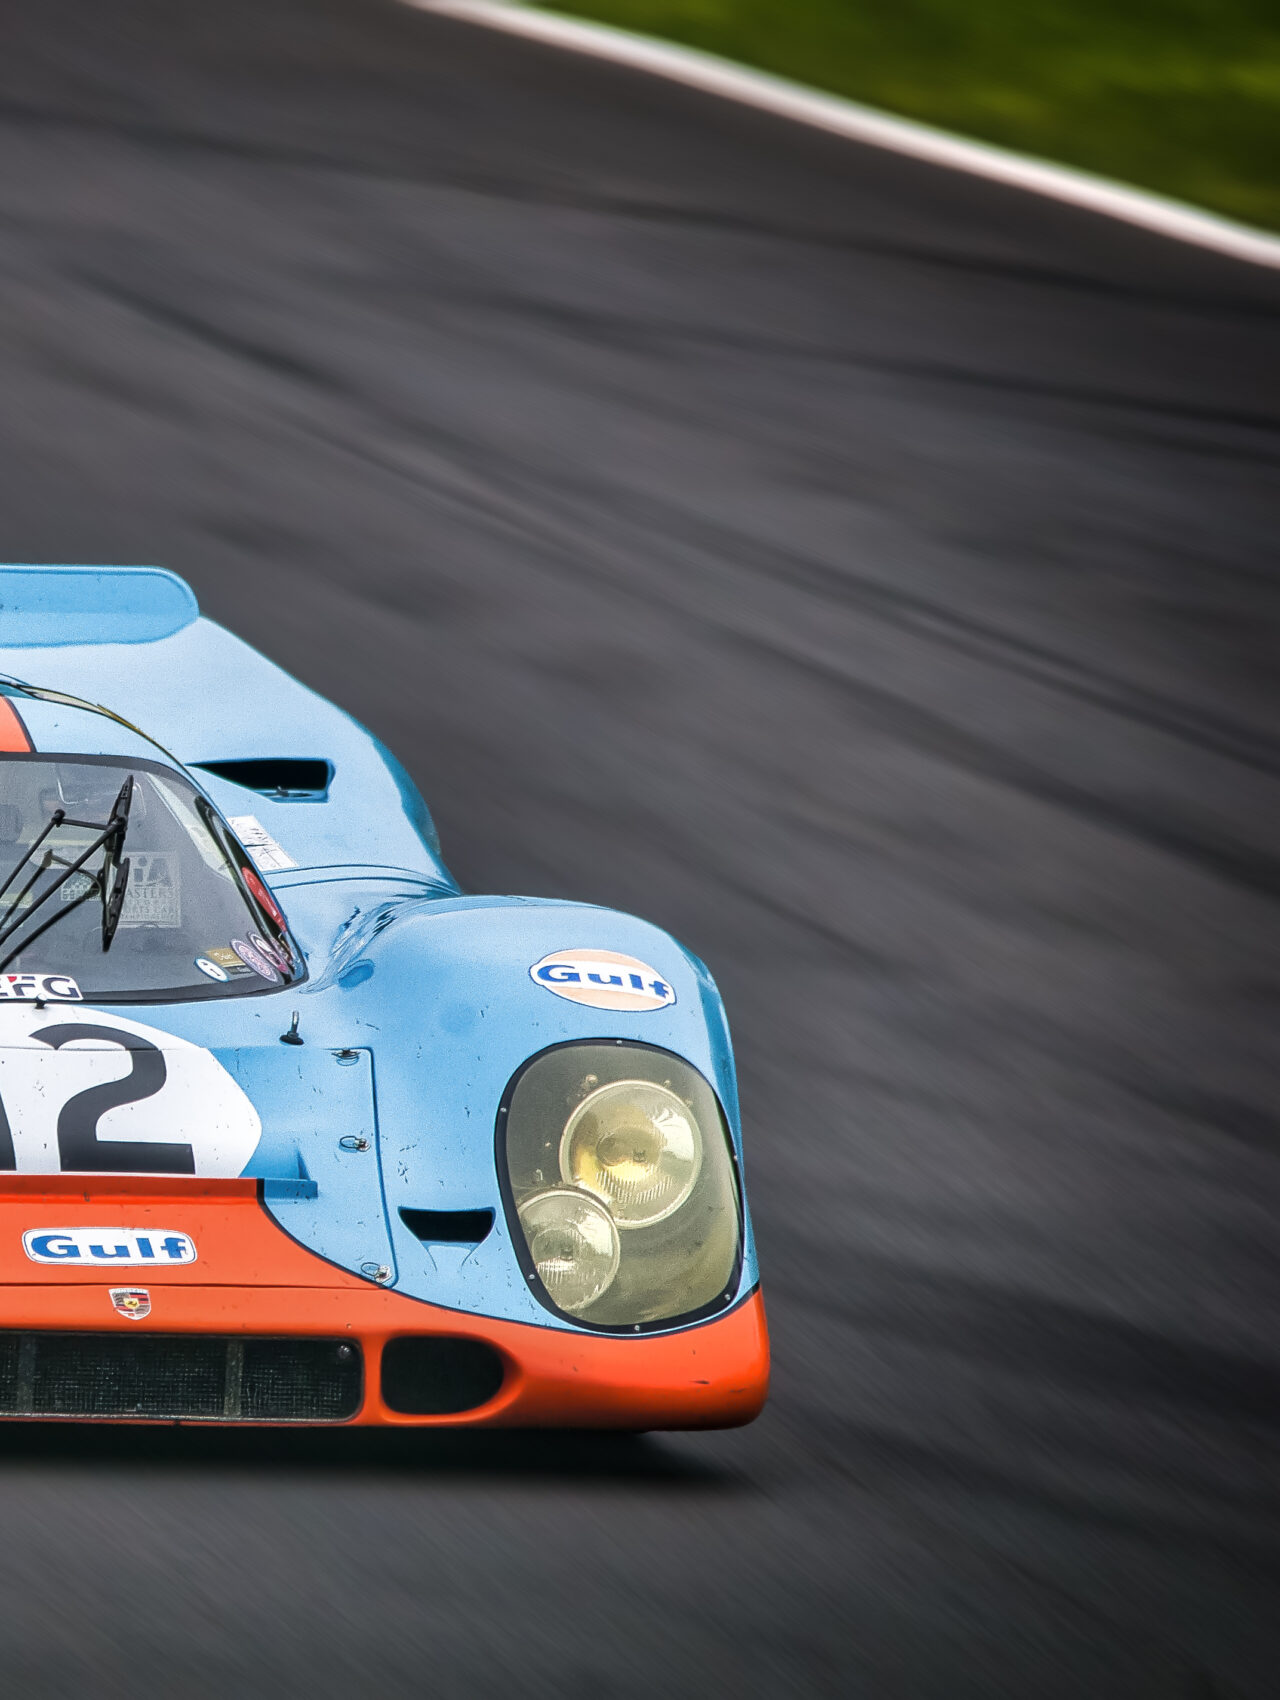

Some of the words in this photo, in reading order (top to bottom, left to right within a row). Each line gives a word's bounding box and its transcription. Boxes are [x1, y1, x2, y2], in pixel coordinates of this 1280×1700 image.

[125, 887, 174, 900] ASTERS
[537, 964, 670, 998] Gulf
[31, 1235, 190, 1259] Gulf
